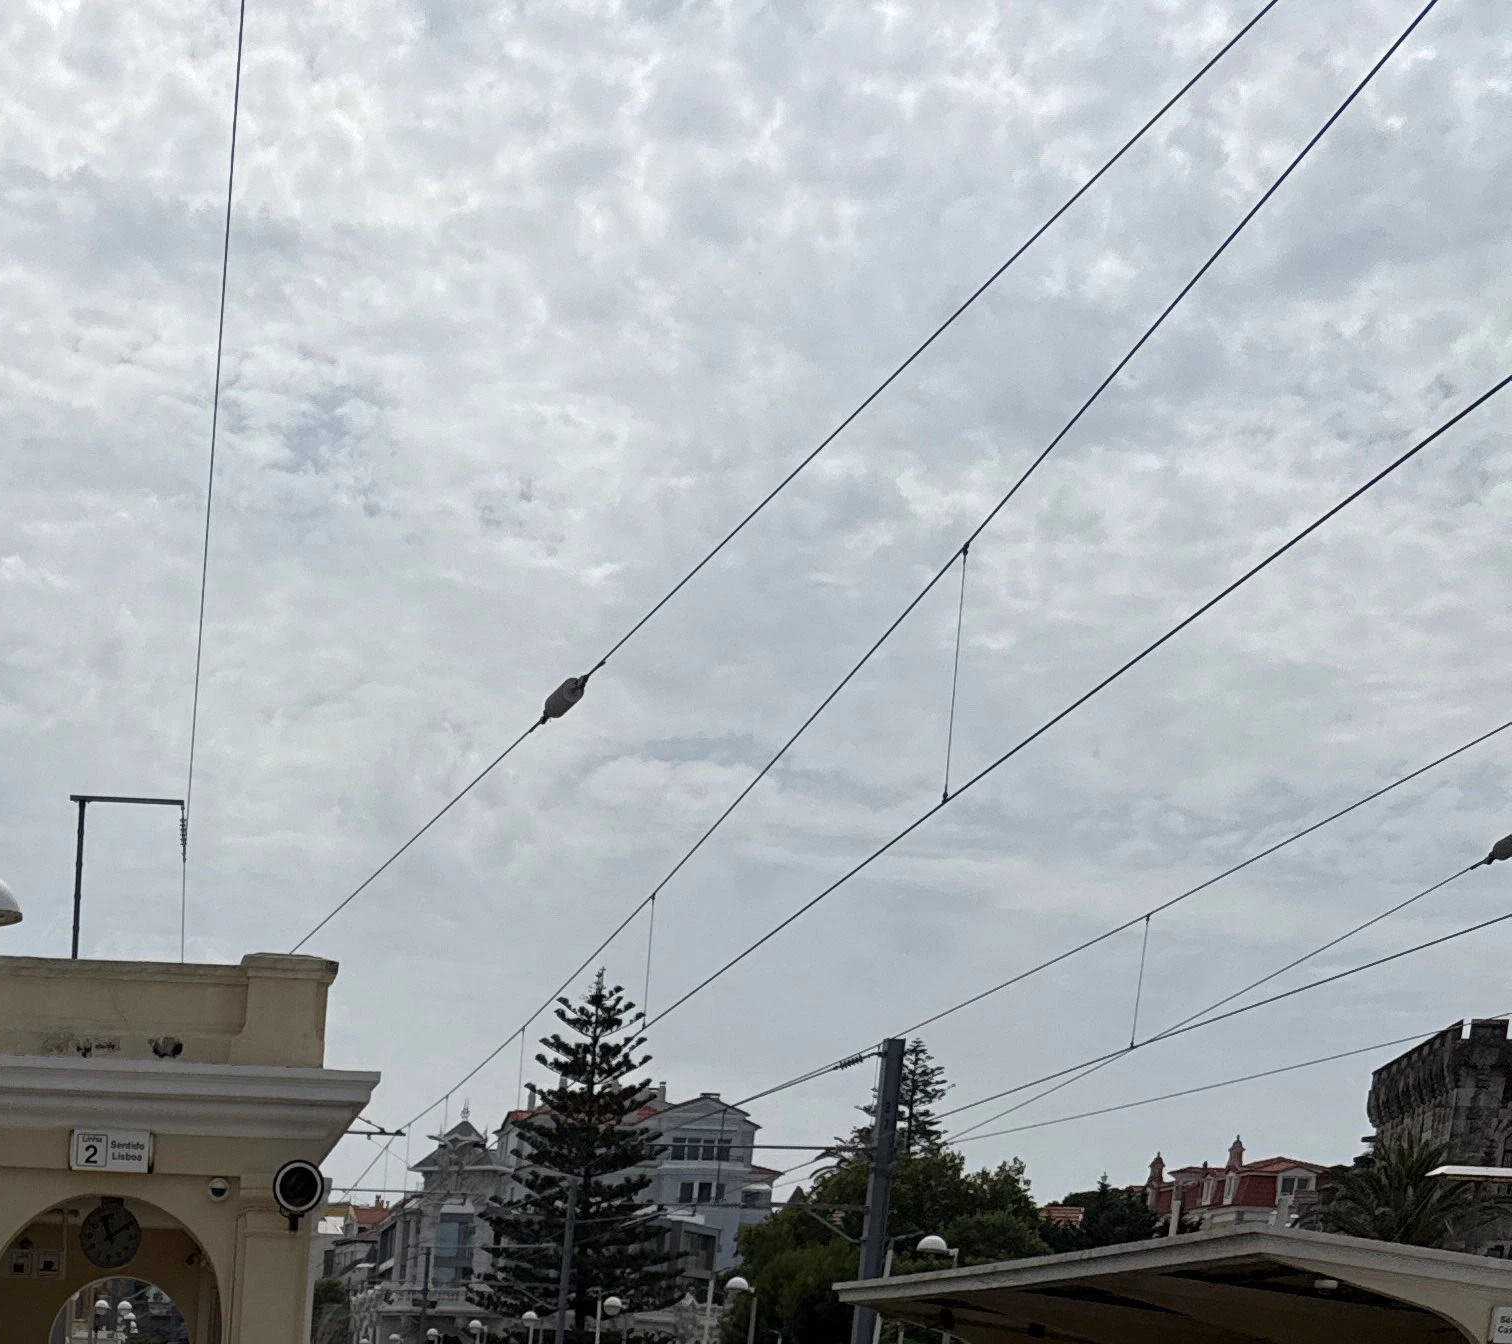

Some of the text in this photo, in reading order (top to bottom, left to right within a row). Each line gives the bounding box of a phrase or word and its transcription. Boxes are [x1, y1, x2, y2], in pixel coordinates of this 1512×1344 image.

[110, 1140, 145, 1151] Sentido
[84, 1144, 98, 1164] 2
[112, 1152, 143, 1162] Lisboa
